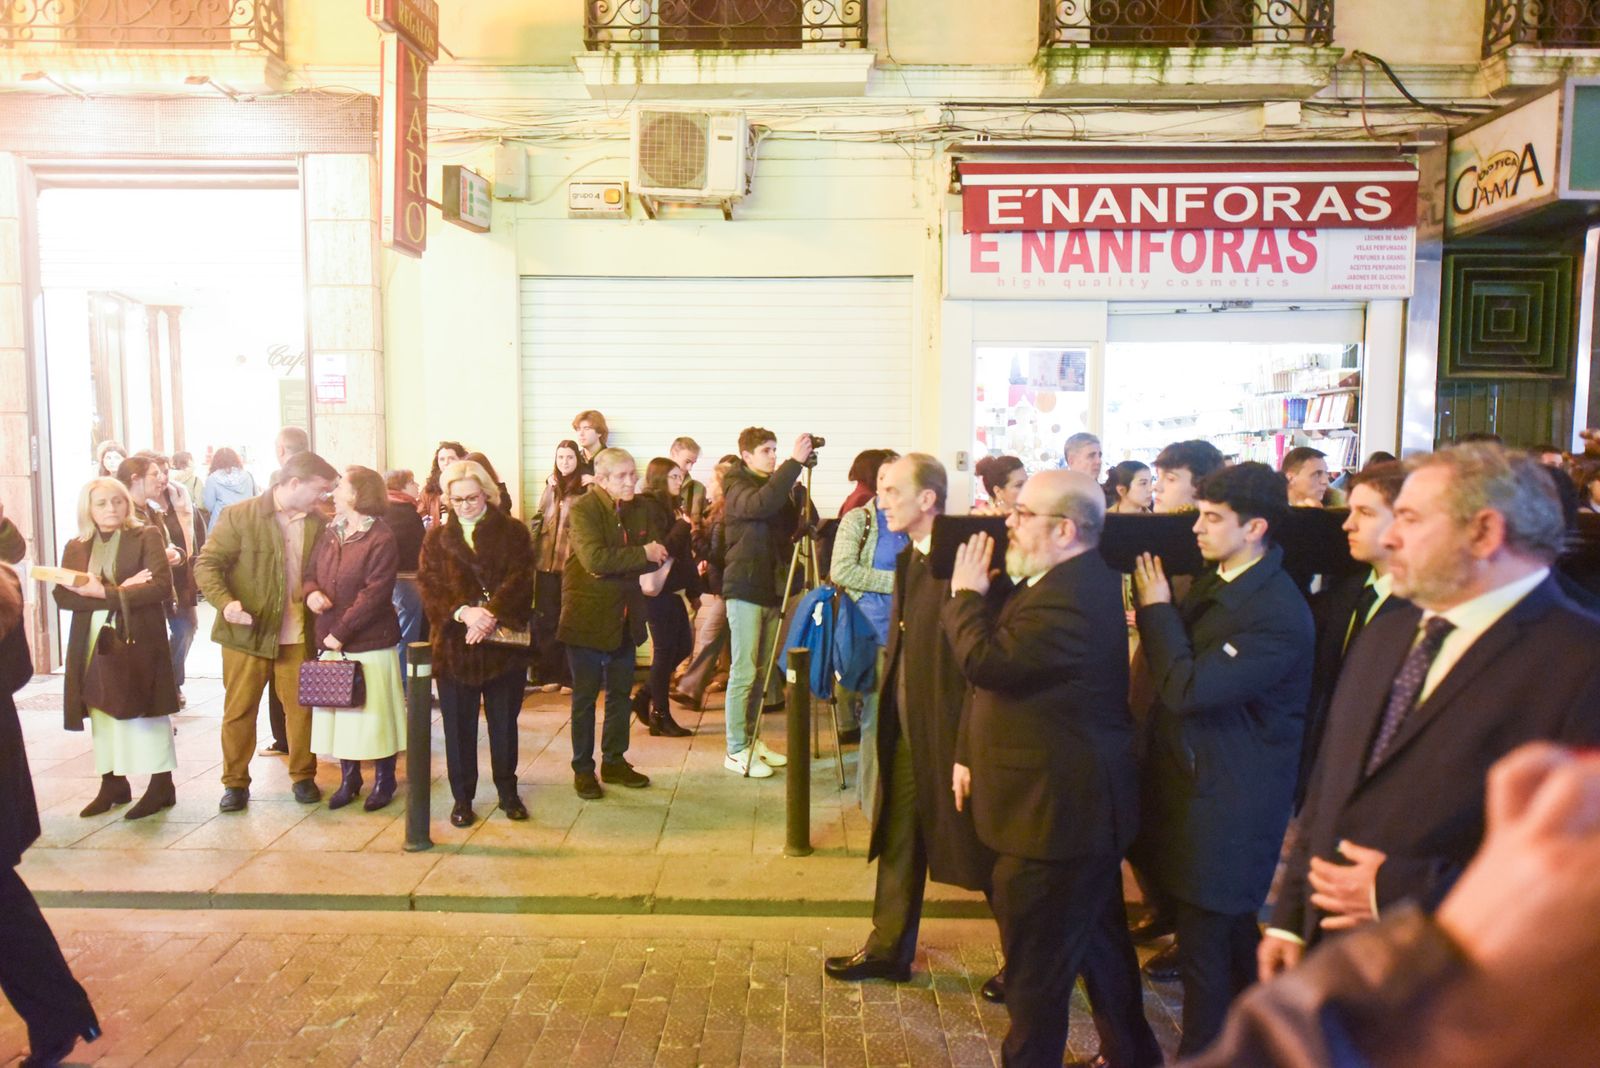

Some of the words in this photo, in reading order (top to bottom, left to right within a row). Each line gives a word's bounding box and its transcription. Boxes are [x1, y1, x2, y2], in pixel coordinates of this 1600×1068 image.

[398, 0, 435, 53] REGALOS
[406, 50, 426, 243] YARO
[571, 192, 593, 200] grupo
[594, 192, 600, 200] 4
[1453, 142, 1544, 215] GAMA
[970, 228, 1318, 274] ENANFORAS
[997, 276, 1046, 289] high
[1063, 276, 1150, 289] quality
[1166, 277, 1289, 288] cosmetics
